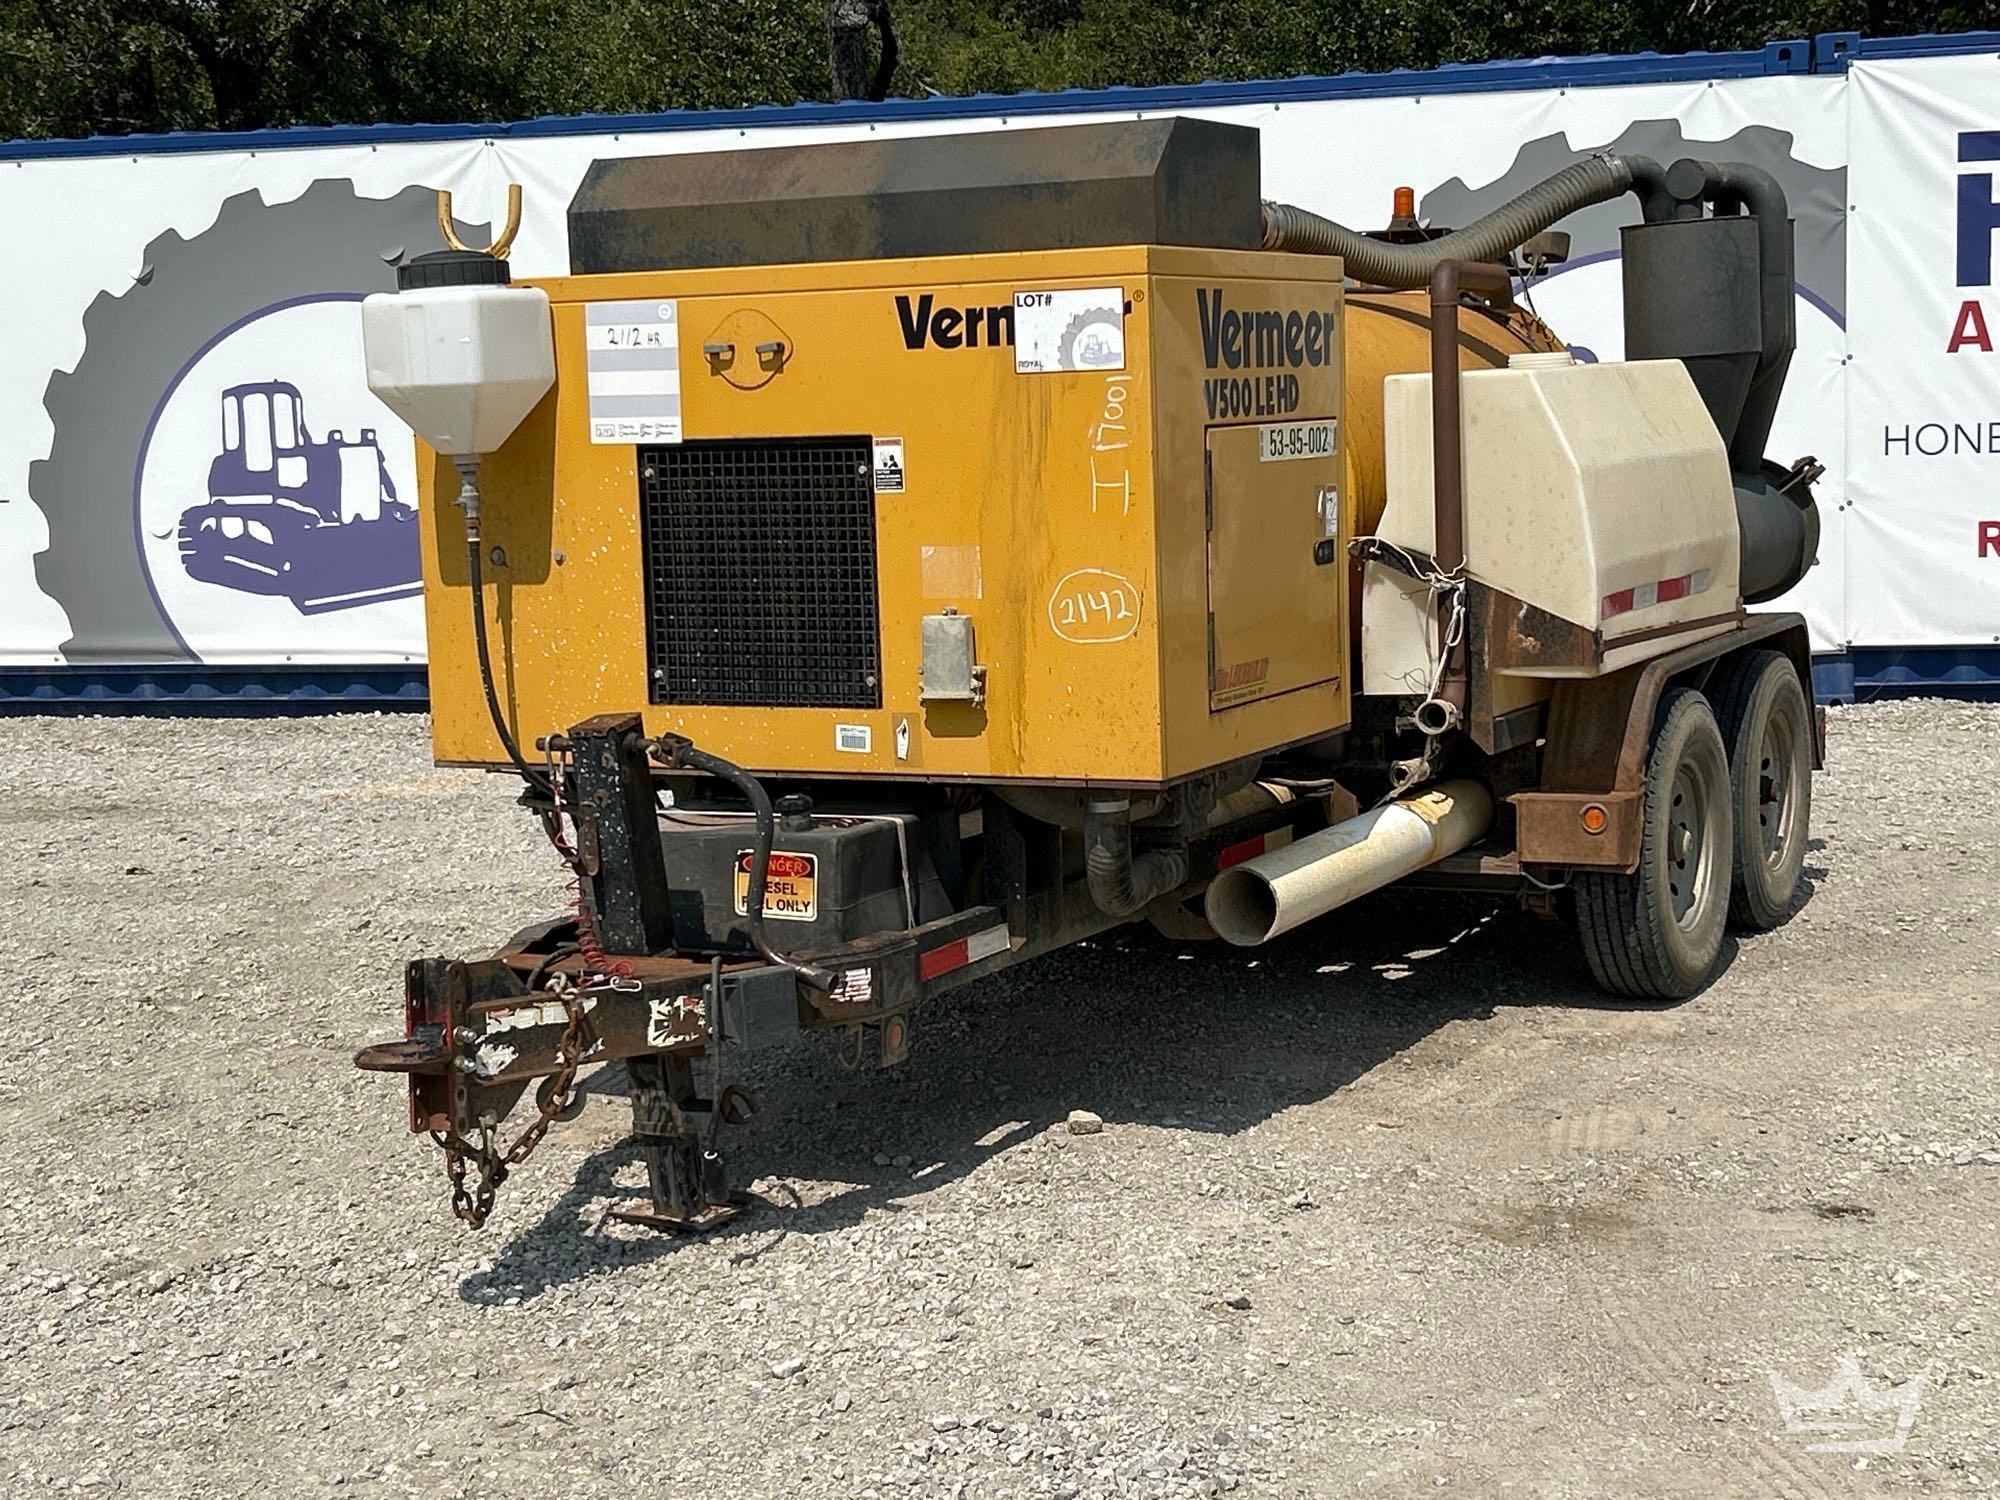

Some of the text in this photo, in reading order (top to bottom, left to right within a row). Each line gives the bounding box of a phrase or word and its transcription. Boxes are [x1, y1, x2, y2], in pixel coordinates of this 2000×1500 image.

[1016, 294, 1053, 308] LOT#
[607, 327, 642, 347] 2112
[1197, 288, 1334, 369] Vermeer
[1269, 426, 1329, 457] 53-95-002
[1058, 590, 1133, 627] 2142
[765, 881, 798, 896] ESEL
[742, 896, 811, 912] FL ONLY
